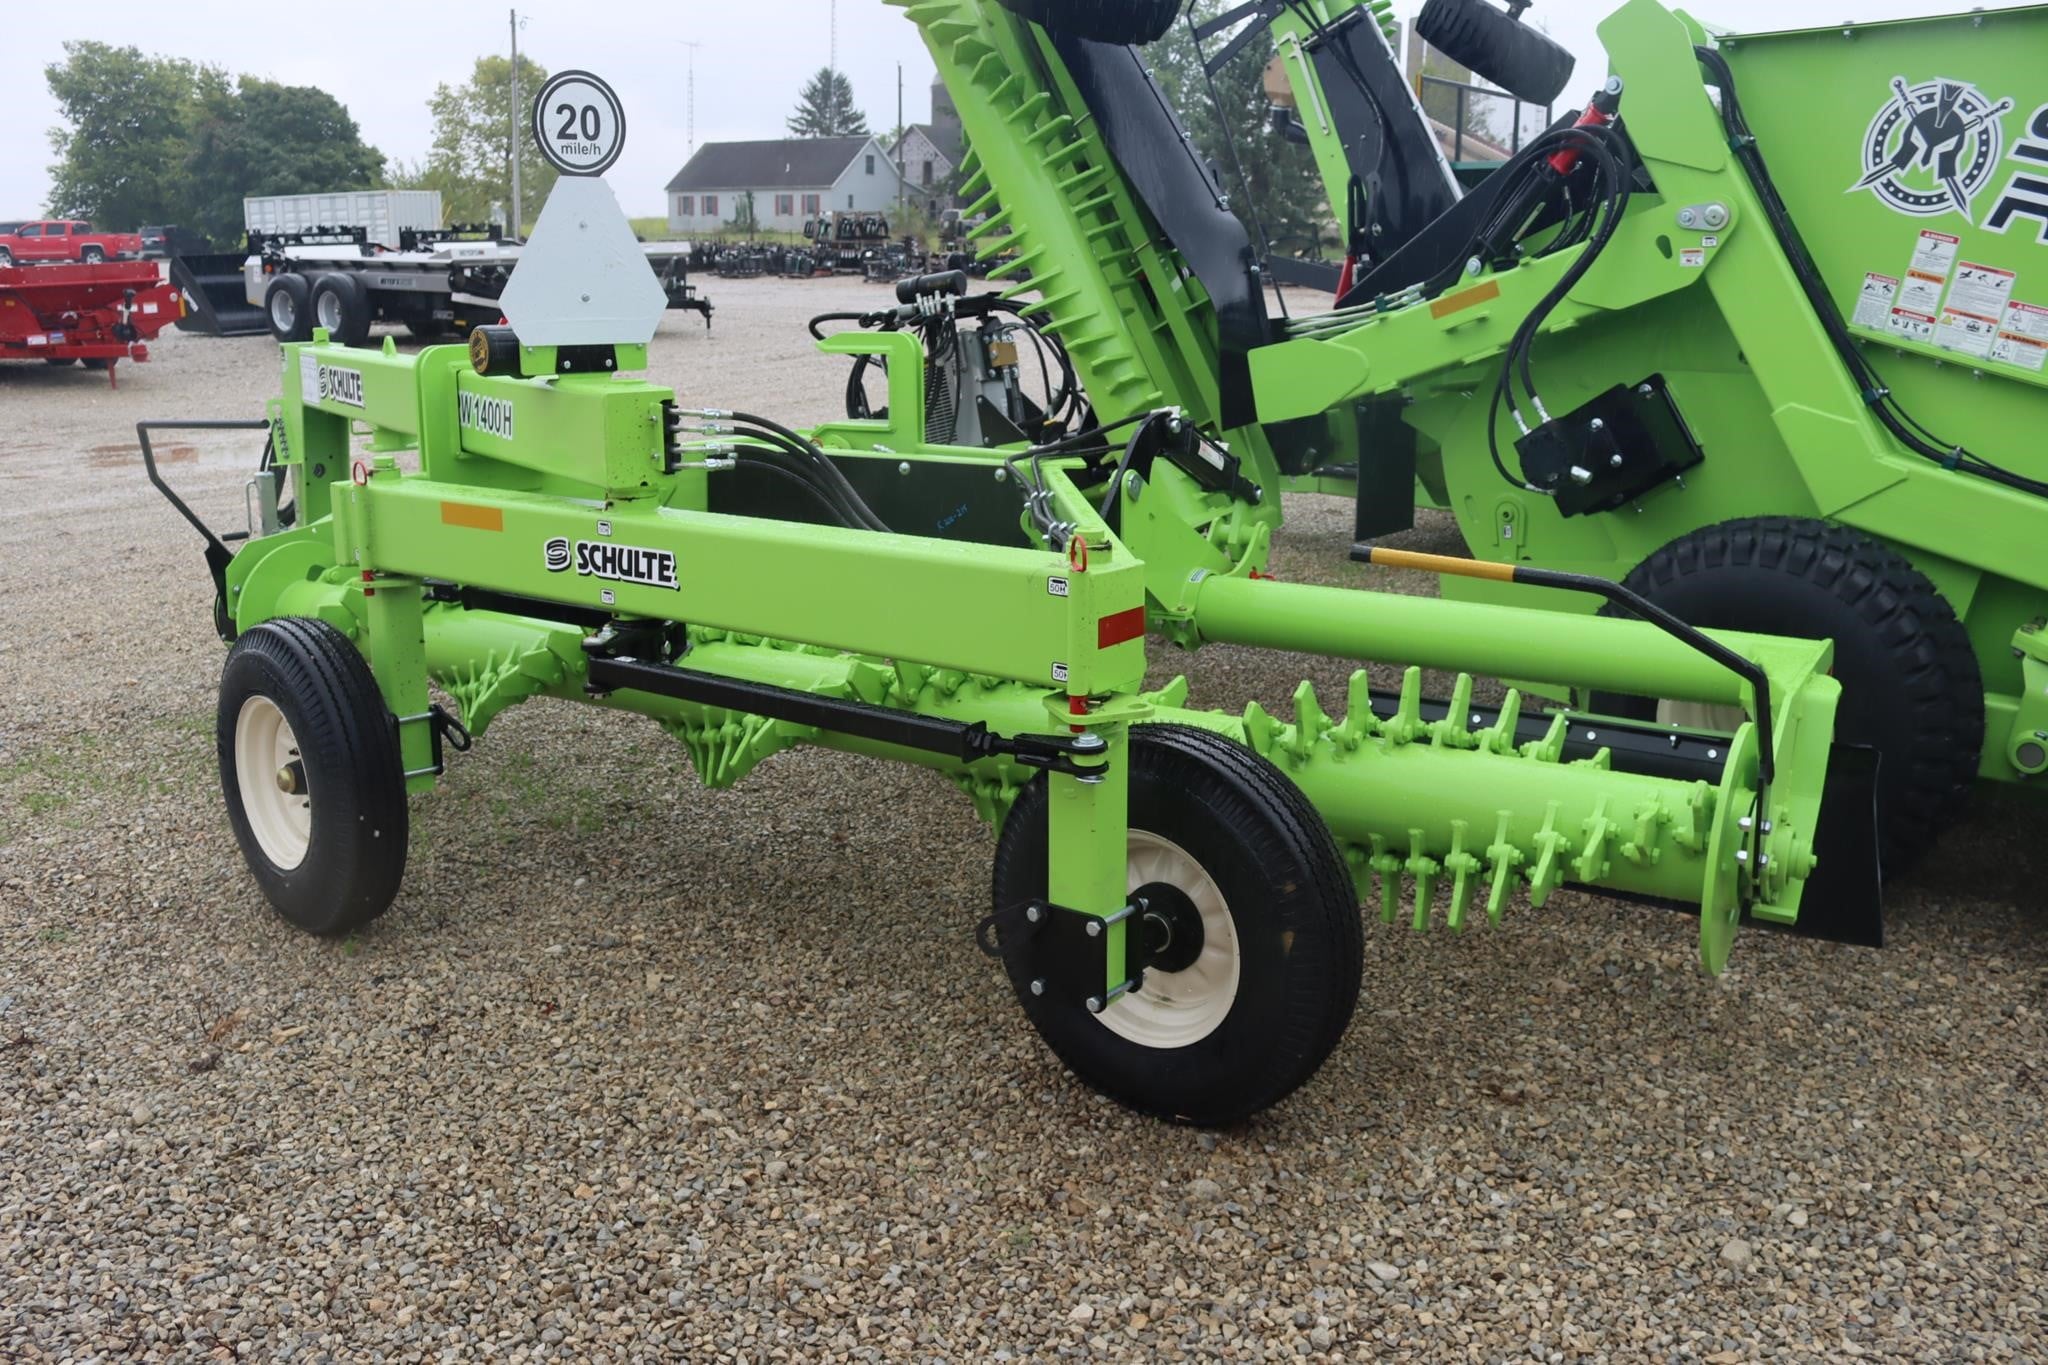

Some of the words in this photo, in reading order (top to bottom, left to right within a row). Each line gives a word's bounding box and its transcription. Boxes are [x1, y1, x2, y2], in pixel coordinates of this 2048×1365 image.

[556, 103, 600, 141] 20
[561, 142, 601, 155] mile/h
[328, 368, 362, 402] SCHULTE
[577, 542, 673, 583] SCHULTE
